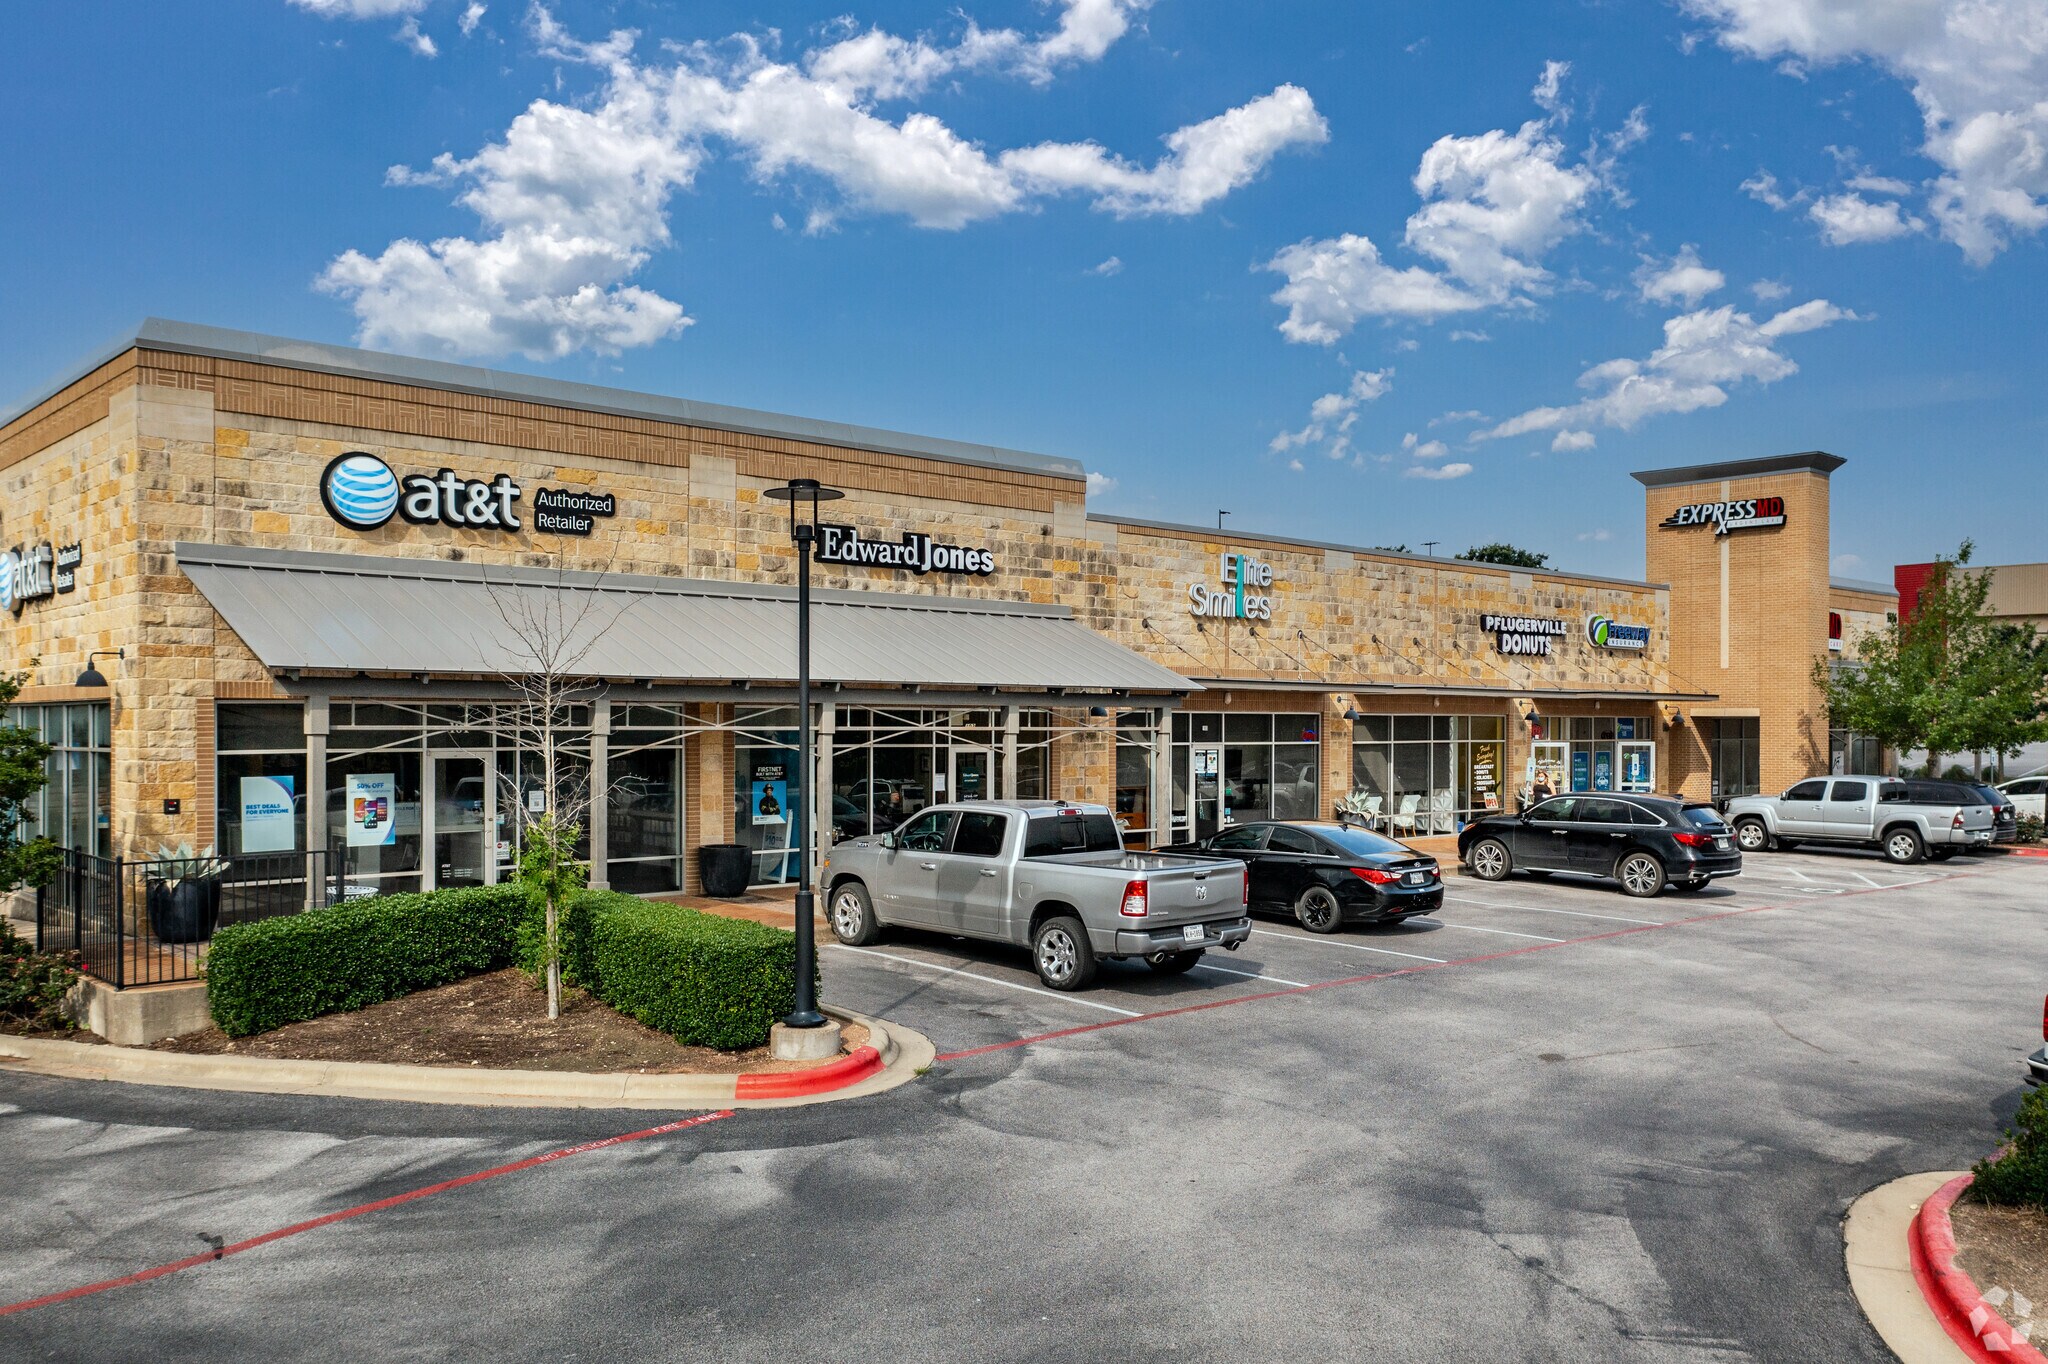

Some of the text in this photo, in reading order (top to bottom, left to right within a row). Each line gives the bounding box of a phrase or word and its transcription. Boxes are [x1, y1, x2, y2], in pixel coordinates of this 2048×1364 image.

[538, 491, 612, 512] Authorized
[538, 513, 590, 531] Retailer
[1221, 552, 1273, 587] Elite
[1188, 583, 1272, 620] Smiles
[1485, 616, 1567, 635] PFLUGERVILLE
[1607, 620, 1650, 645] Freeway
[1502, 634, 1551, 655] DONUTS
[1485, 798, 1498, 807] OPEN
[564, 1137, 620, 1154] PARKING
[651, 1122, 684, 1133] FIRE
[686, 1112, 723, 1125] LANE
